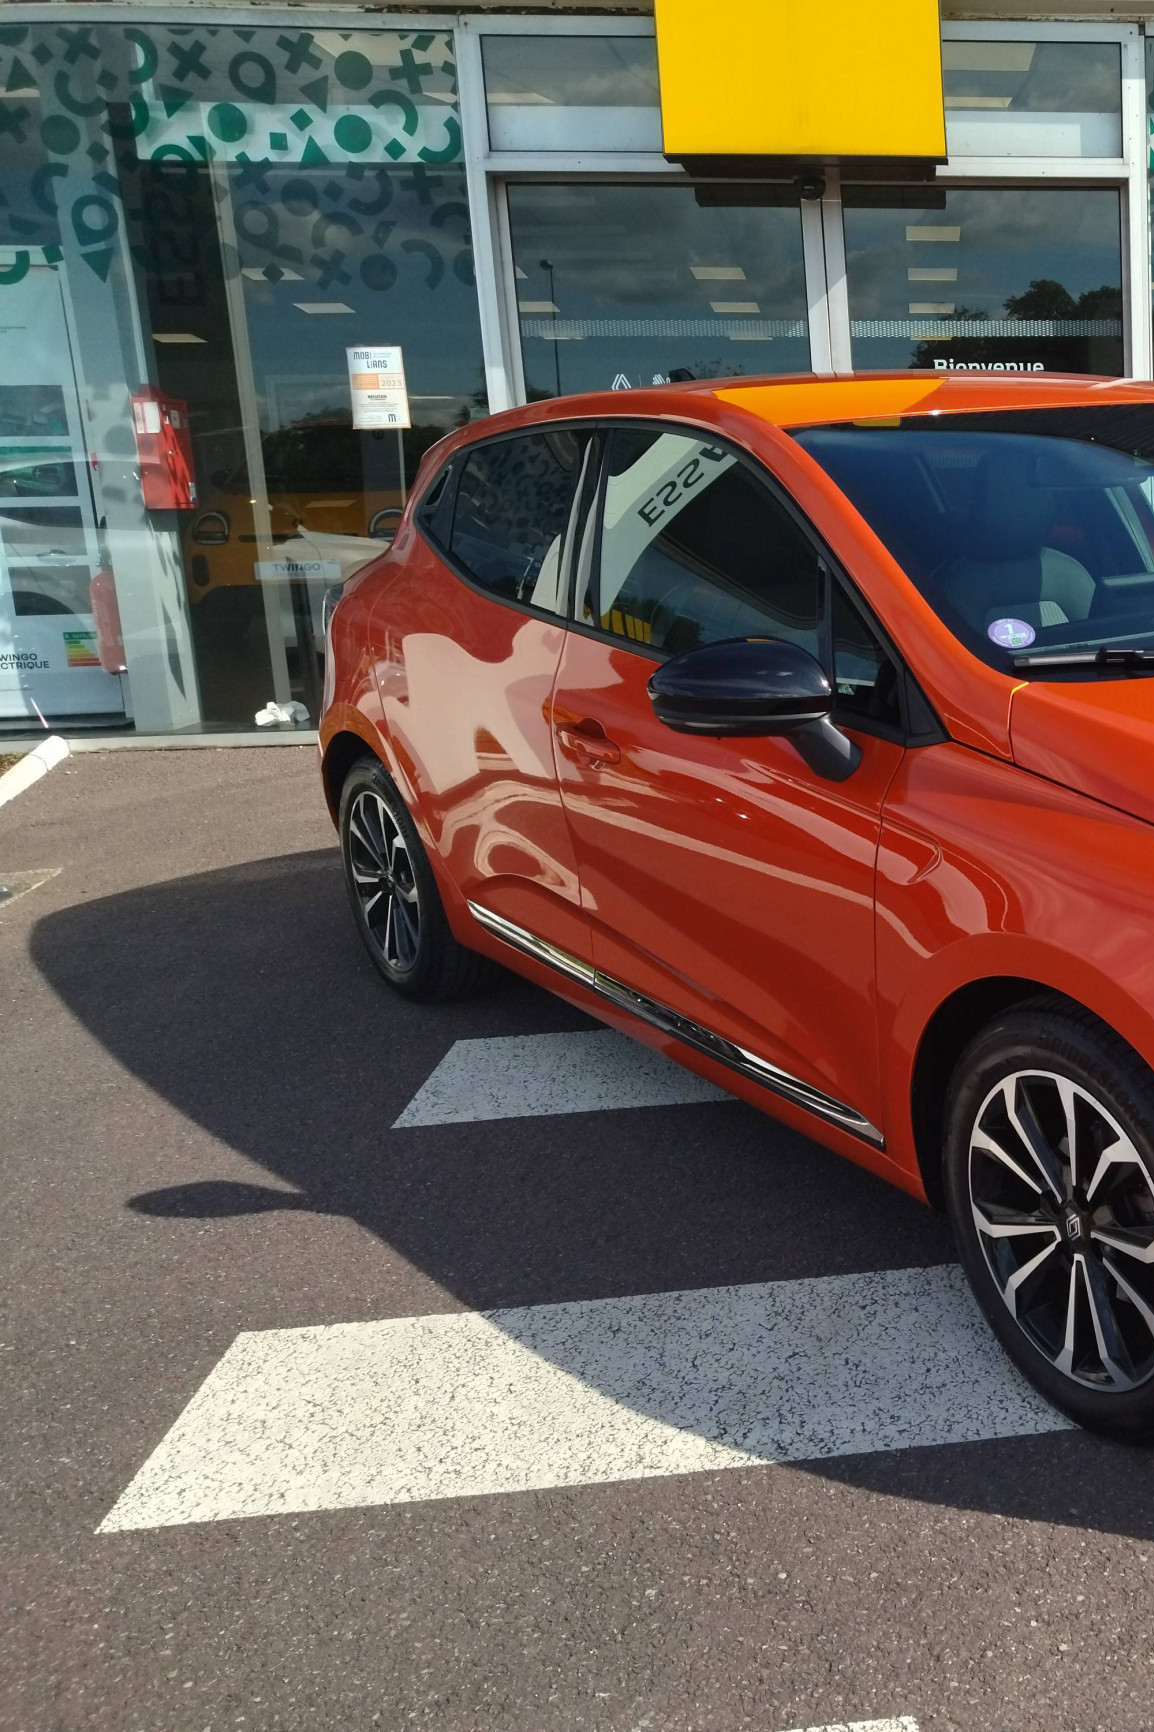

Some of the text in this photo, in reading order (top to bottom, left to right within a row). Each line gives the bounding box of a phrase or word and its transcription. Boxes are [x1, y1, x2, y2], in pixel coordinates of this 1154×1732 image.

[273, 562, 321, 572] TWINGO
[1004, 623, 1014, 635] 1
[0, 660, 51, 670] CTRIQUE
